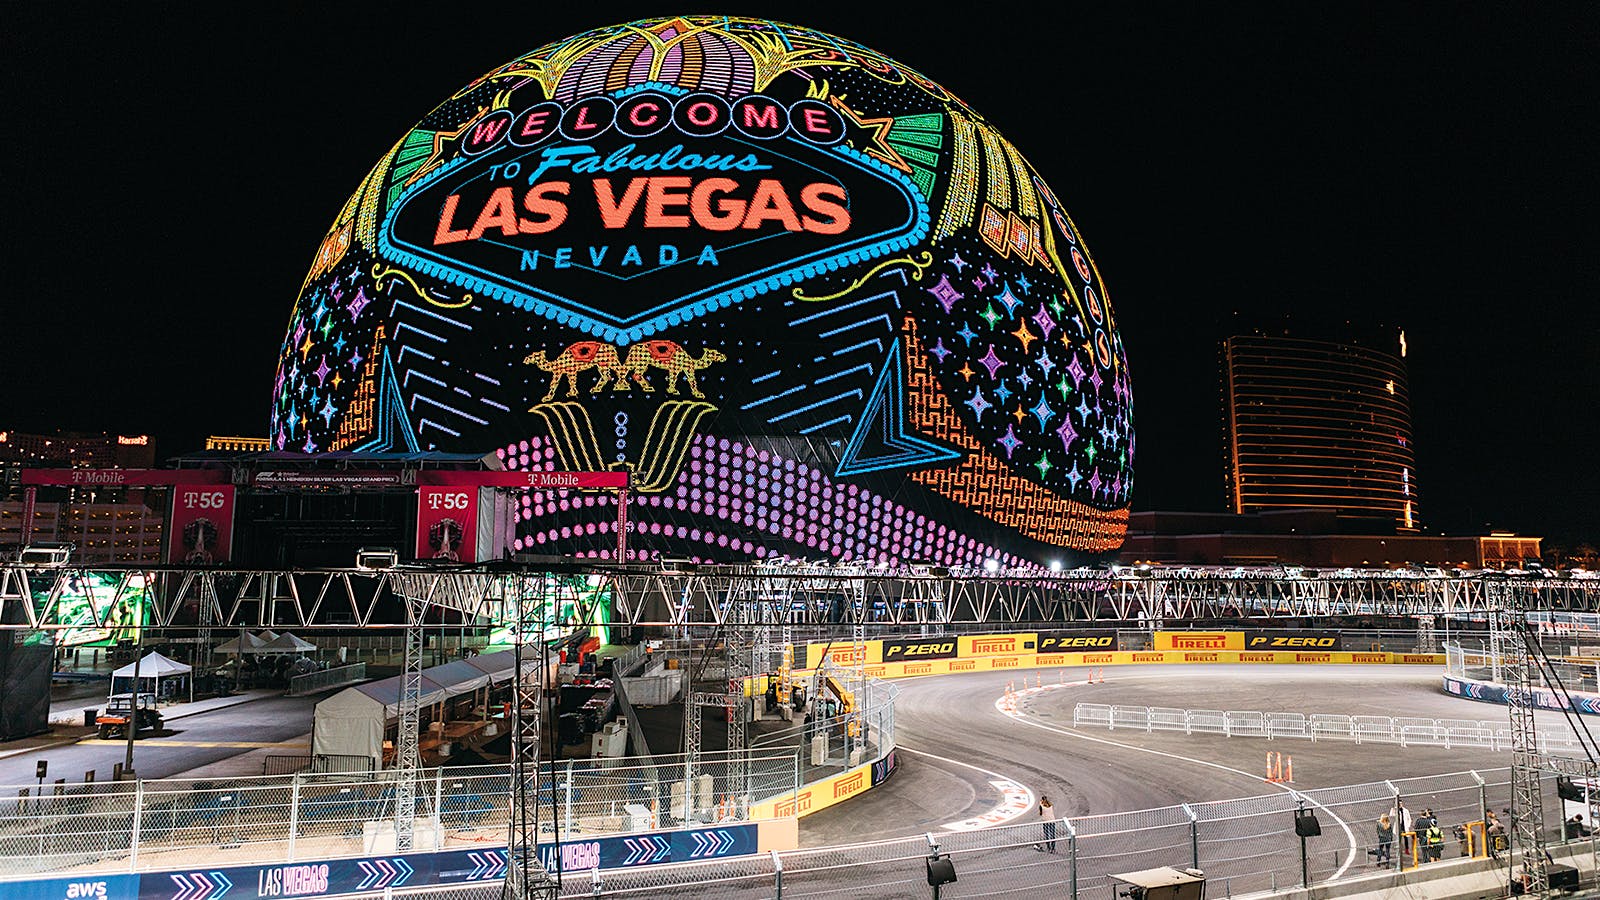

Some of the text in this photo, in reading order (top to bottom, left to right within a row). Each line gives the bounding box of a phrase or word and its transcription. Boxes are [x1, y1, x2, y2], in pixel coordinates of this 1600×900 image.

[471, 102, 831, 145] WELCOME
[489, 144, 773, 185] TO Fabulous
[433, 175, 852, 246] LAS VEGAS
[520, 244, 721, 270] NEVADA
[85, 471, 125, 483] Mobile
[541, 473, 579, 485] Mobile
[199, 492, 224, 508] 5G
[444, 493, 468, 509] 5G
[972, 637, 1016, 653] PIRELLI
[1041, 637, 1113, 648] P ZERO
[1172, 634, 1226, 648] PIRELLI
[1250, 637, 1336, 647] P ZERO
[822, 645, 867, 664] PRELLI
[887, 643, 954, 657] P ZERO
[992, 657, 1019, 667] PIRELLI
[1036, 655, 1064, 665] PIRELLI
[1083, 654, 1112, 663] PIRELLI
[1132, 653, 1164, 662] PIRELLI
[1184, 653, 1218, 662] PIRELLI
[1239, 653, 1274, 662] PIRELLI
[1296, 653, 1330, 662] PIRELLI
[1352, 654, 1386, 663] PIRELLI
[1403, 655, 1434, 663] PIRELLI
[904, 663, 931, 674] PIRELLI
[949, 660, 975, 671] PIRELLI
[833, 772, 863, 798] PIRELLI
[774, 791, 812, 818] PIRELLI
[562, 841, 600, 871] VEGAS
[258, 863, 329, 897] LAS VEGAS
[66, 881, 107, 898] aws
